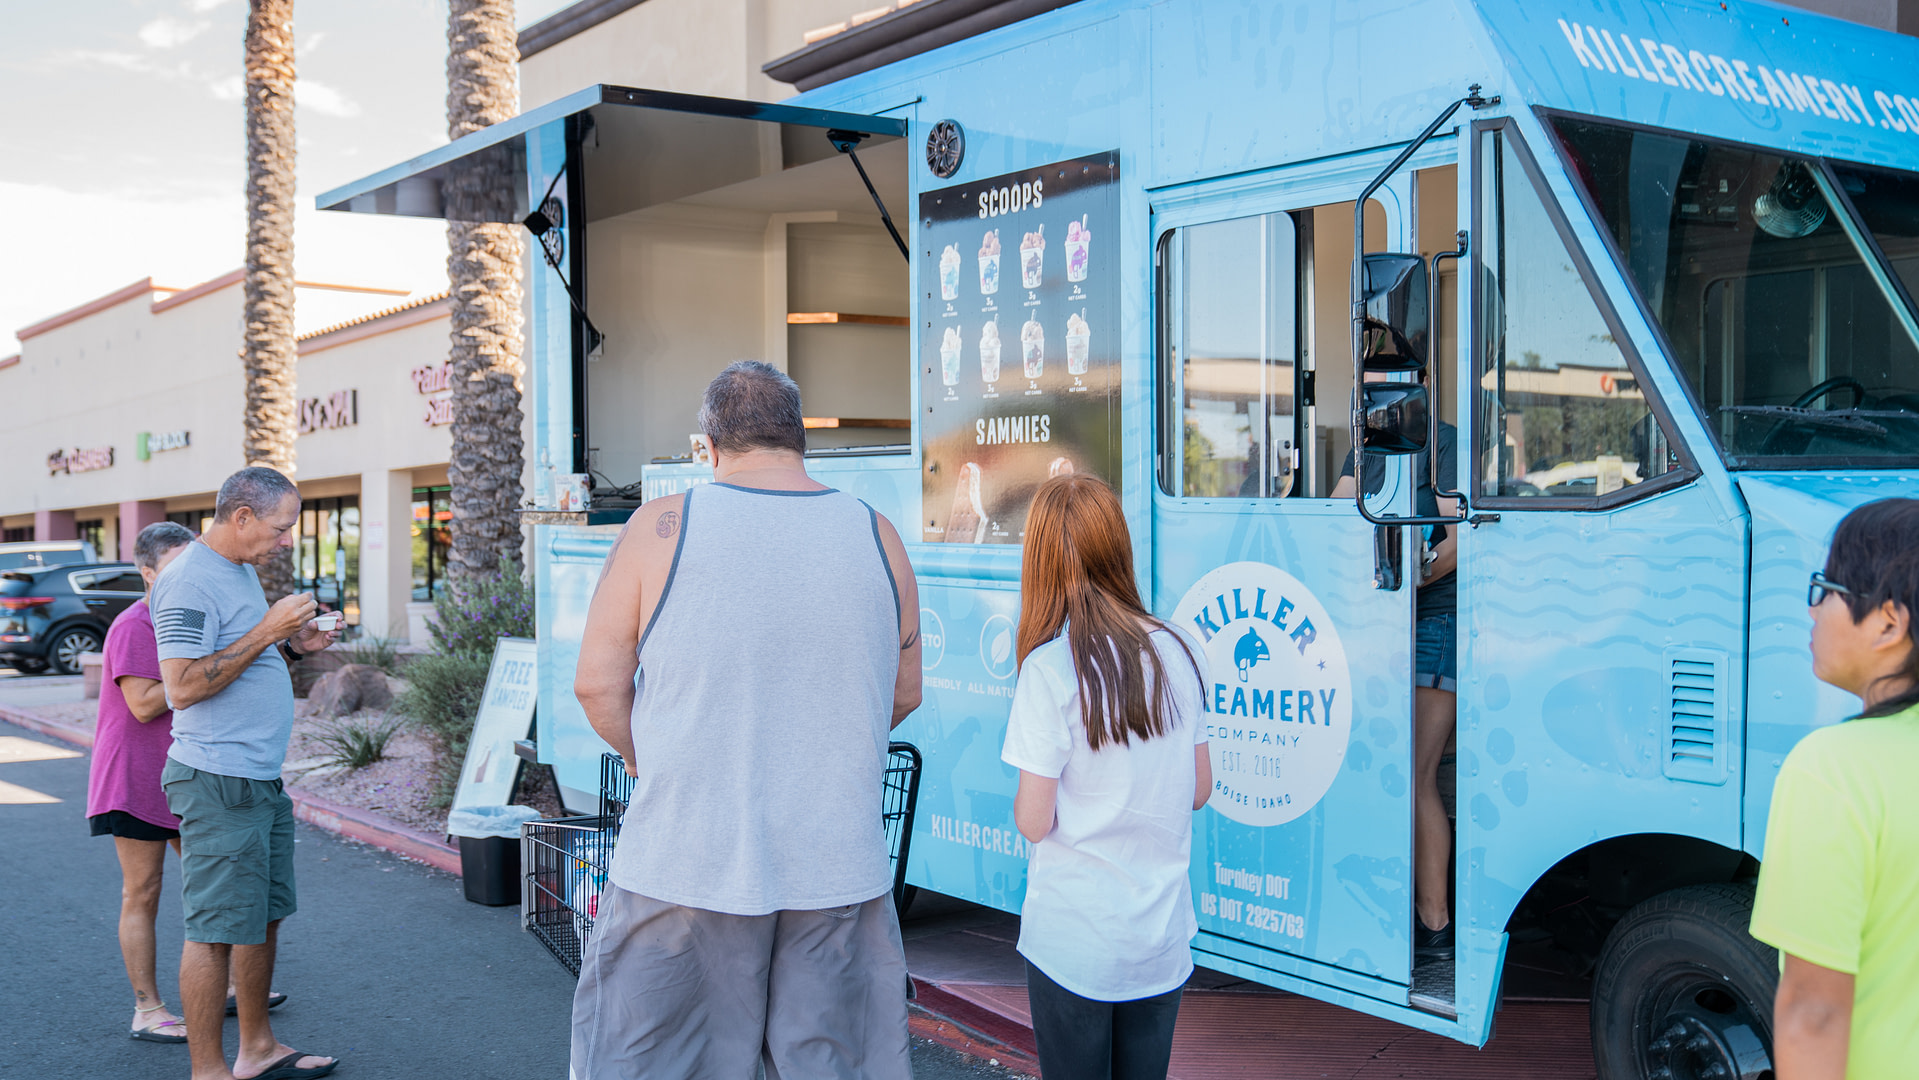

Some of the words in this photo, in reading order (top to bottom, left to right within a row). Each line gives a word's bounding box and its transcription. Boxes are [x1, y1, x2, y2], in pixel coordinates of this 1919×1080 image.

[979, 180, 1043, 219] SCOOPS
[975, 414, 1051, 445] SAMMIES
[1194, 587, 1317, 656] KILLER
[500, 659, 534, 685] FREE
[490, 687, 531, 711] SAMPLES
[967, 682, 985, 694] ALL
[1206, 725, 1300, 748] COMPANY
[1254, 754, 1281, 778] 2016
[1216, 780, 1248, 806] BOISE
[1256, 793, 1292, 809] IDAHO
[1214, 862, 1264, 897] Turnkey
[1265, 873, 1291, 900] DOT
[1201, 891, 1217, 916] US
[1219, 896, 1244, 923] DOT
[1246, 903, 1304, 939] 2825763
